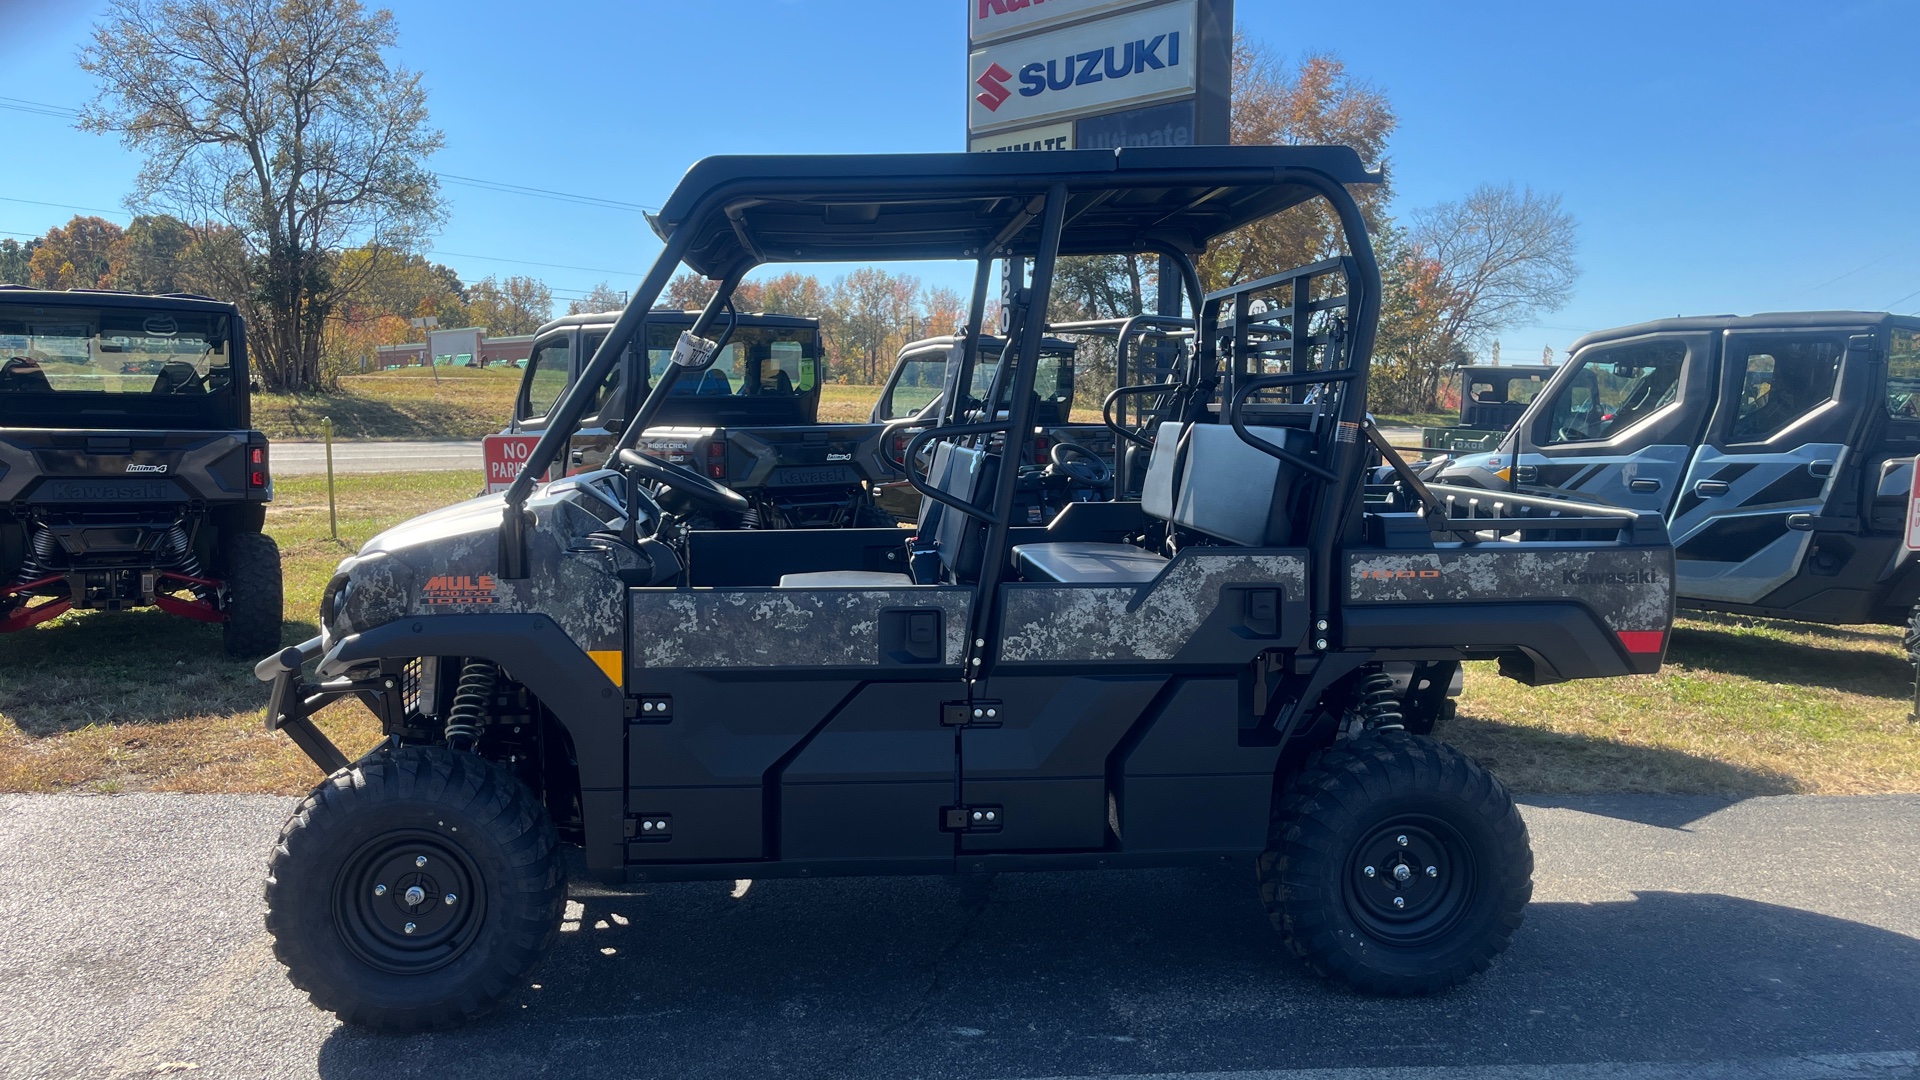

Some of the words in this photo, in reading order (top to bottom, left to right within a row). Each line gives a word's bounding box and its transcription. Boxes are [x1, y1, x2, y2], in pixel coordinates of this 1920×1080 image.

[1018, 31, 1180, 97] SUZUKI
[503, 443, 528, 459] NO
[780, 468, 846, 485] Kawasaki
[53, 483, 167, 499] Kawasaki
[423, 575, 497, 591] MULE
[1562, 568, 1656, 584] Kawasaki
